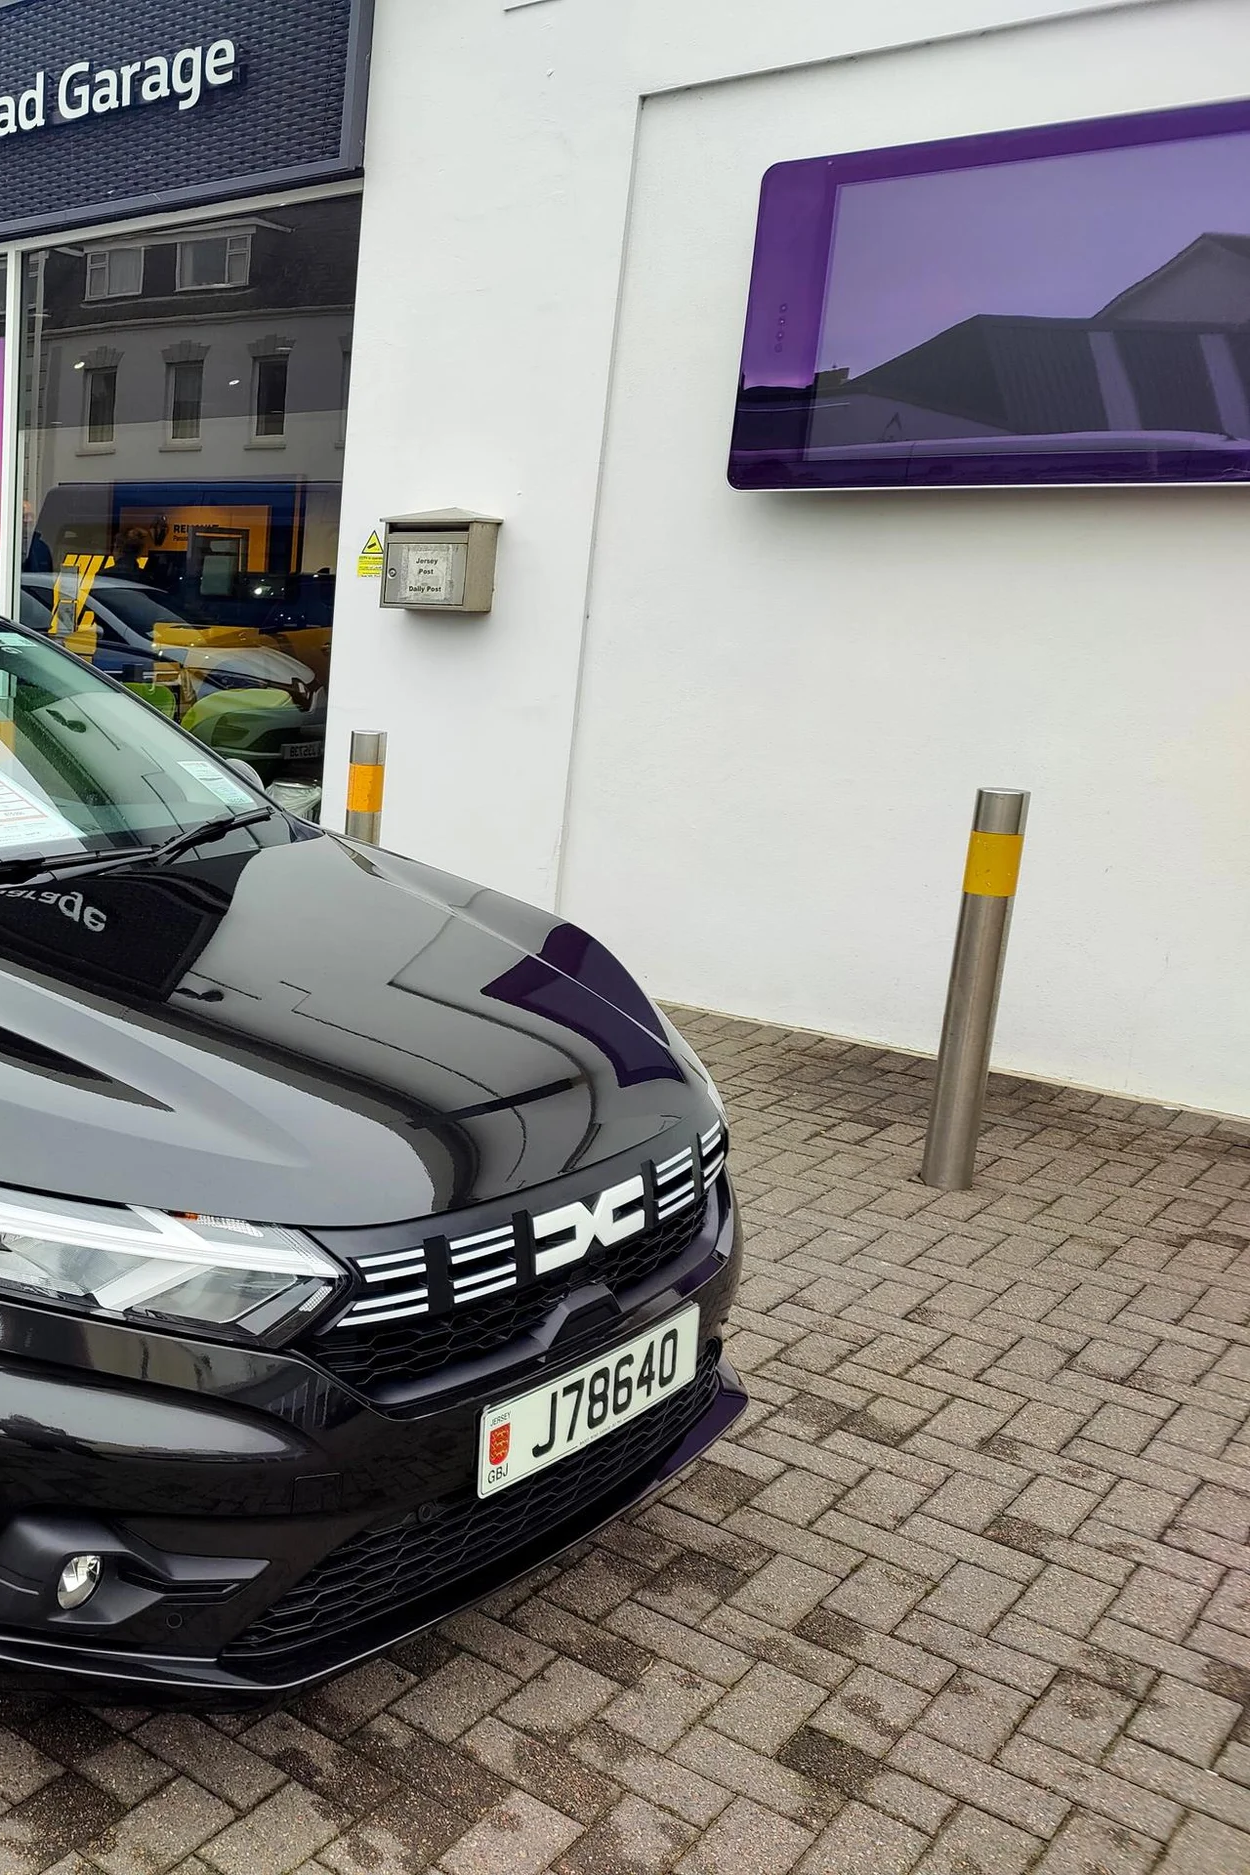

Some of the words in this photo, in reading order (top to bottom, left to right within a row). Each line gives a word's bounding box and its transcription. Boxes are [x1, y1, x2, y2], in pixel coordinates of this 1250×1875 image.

[58, 38, 236, 119] Garage
[409, 585, 425, 593] Daily
[532, 1328, 678, 1458] J78640
[490, 1411, 511, 1427] JERSEY
[487, 1463, 508, 1484] GBJ
